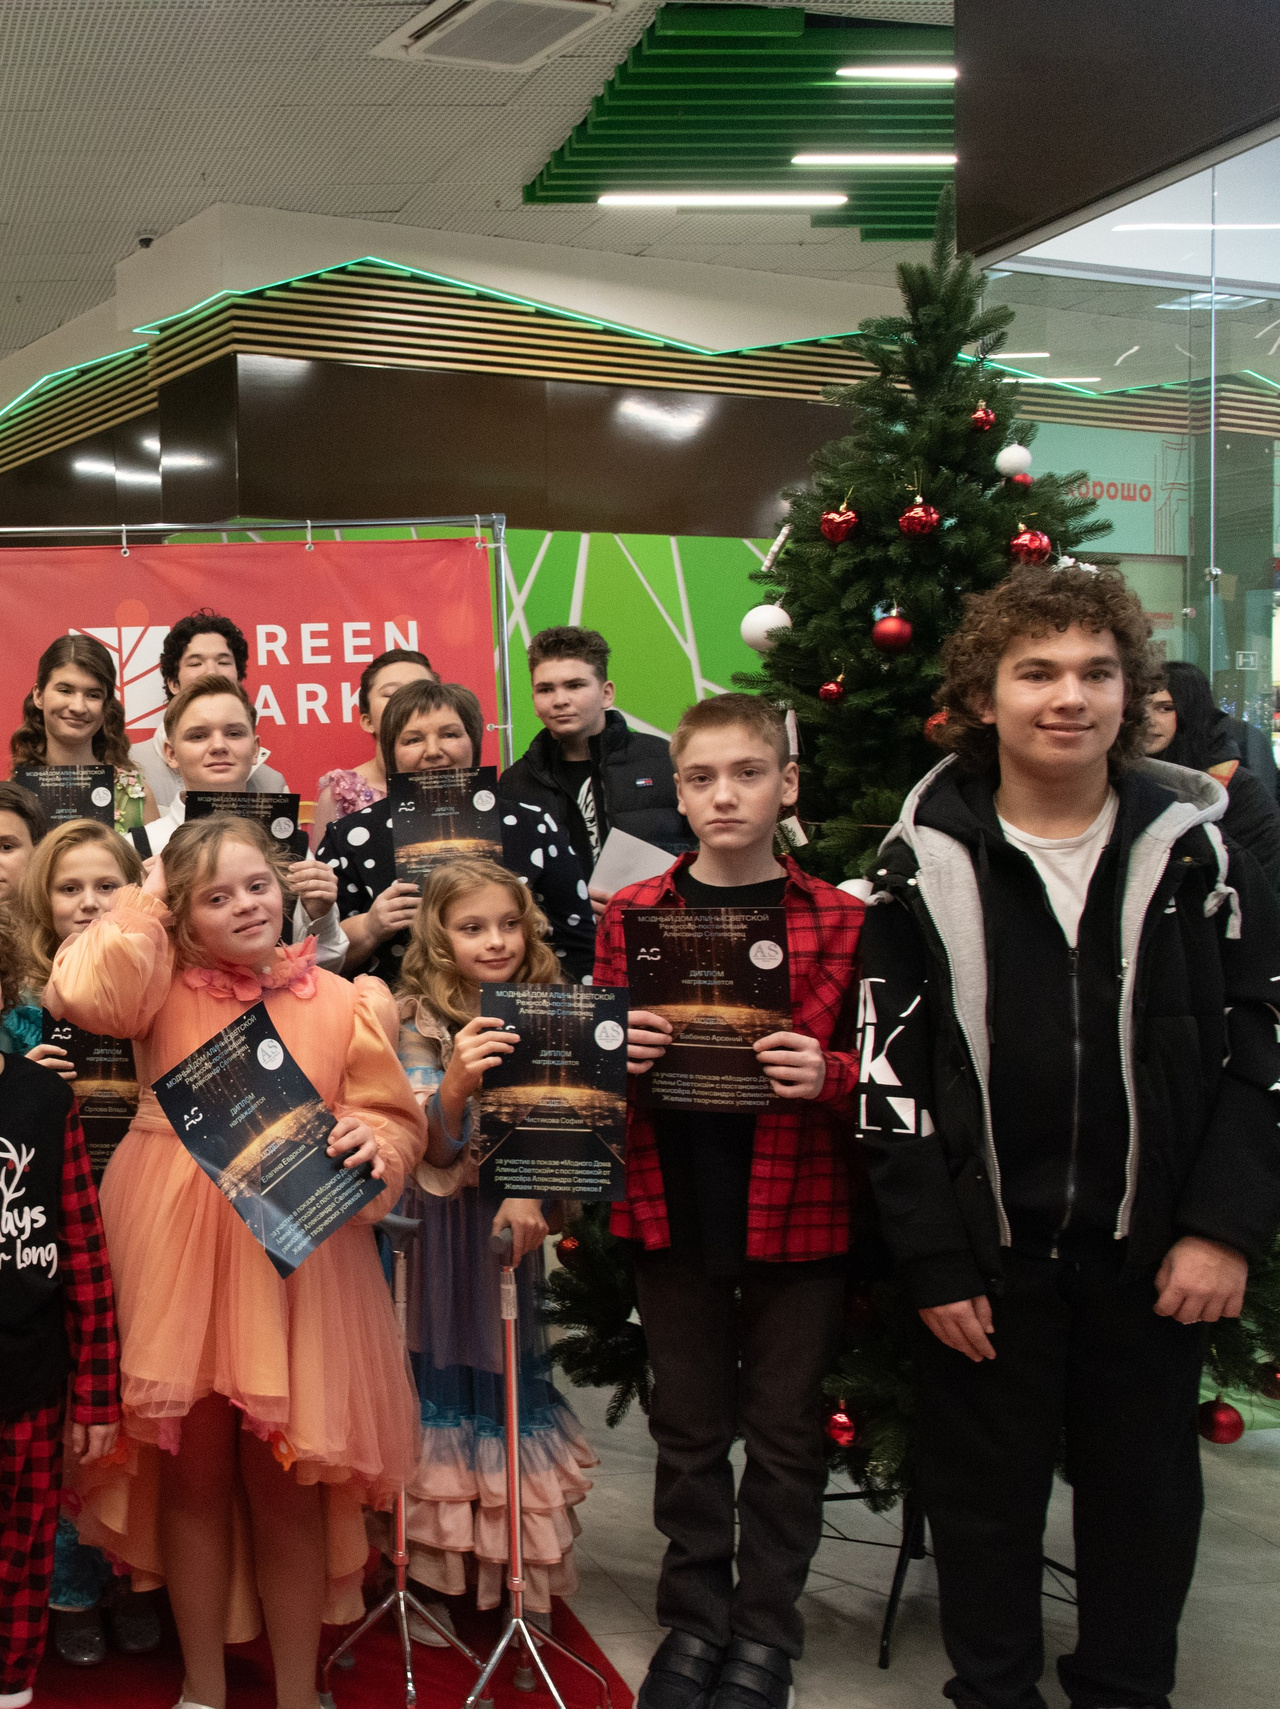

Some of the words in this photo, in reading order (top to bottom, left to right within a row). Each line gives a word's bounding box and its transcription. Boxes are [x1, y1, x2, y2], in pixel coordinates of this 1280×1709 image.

[256, 620, 418, 666] REEN
[255, 681, 362, 726] ARK
[674, 915, 693, 923] ДОМ
[636, 947, 662, 961] AS
[753, 943, 779, 958] AS
[689, 970, 725, 978] ДИПЛОМ
[597, 1025, 621, 1039] AS
[191, 1054, 207, 1069] ДОМ
[539, 1050, 572, 1058] ДИПЛОМ
[229, 1092, 256, 1116] ДИПЛОМ
[15, 1240, 58, 1279] Long
